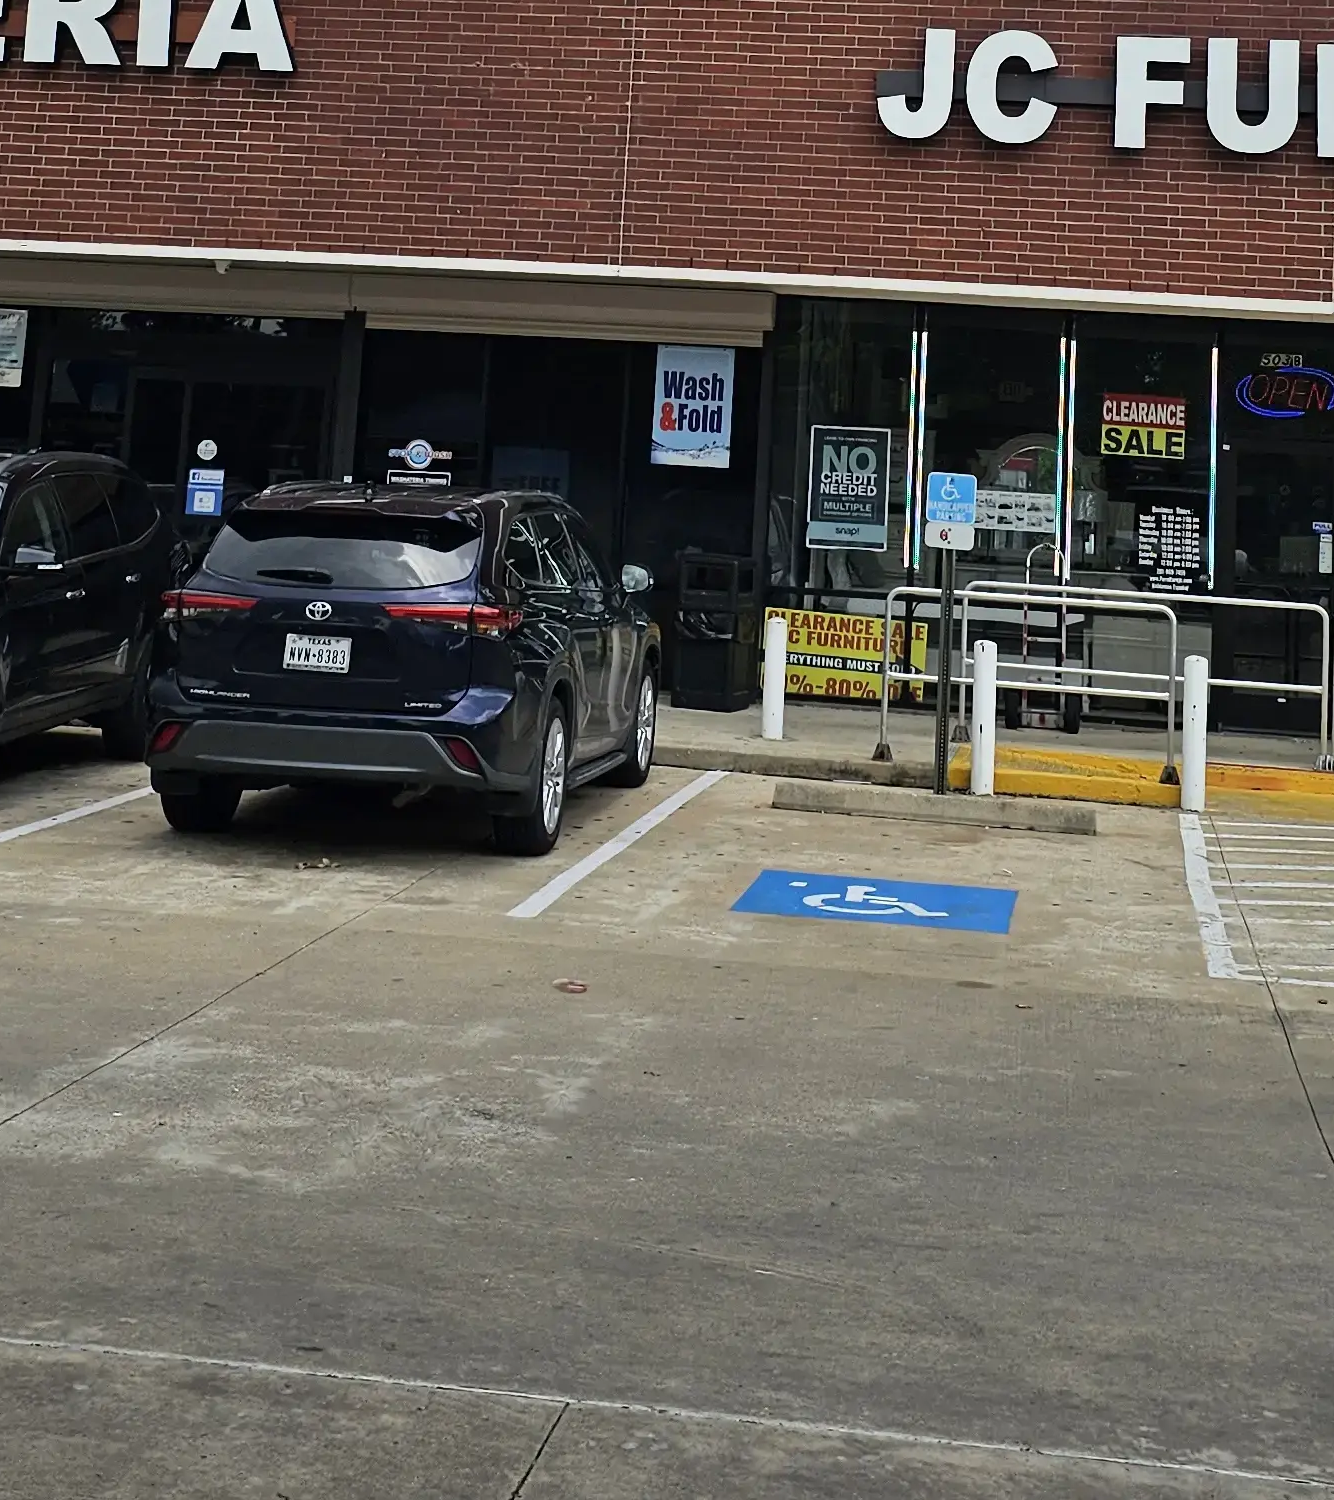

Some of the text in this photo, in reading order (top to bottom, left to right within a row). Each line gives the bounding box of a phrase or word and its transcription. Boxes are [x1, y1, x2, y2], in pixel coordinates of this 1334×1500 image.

[876, 28, 1059, 145] JC
[663, 370, 725, 401] Wash
[1249, 374, 1329, 411] OPEN
[1103, 399, 1186, 426] CLEARANCE
[1103, 427, 1184, 457] SALE
[822, 444, 877, 474] NO
[820, 471, 878, 486] CREDIT
[819, 482, 877, 496] NEEDED
[823, 501, 872, 512] MULTIPLE
[835, 527, 860, 537] snap!
[881, 621, 925, 641] SAE
[847, 660, 880, 672] MUST
[190, 688, 250, 699] HIGHLANDER
